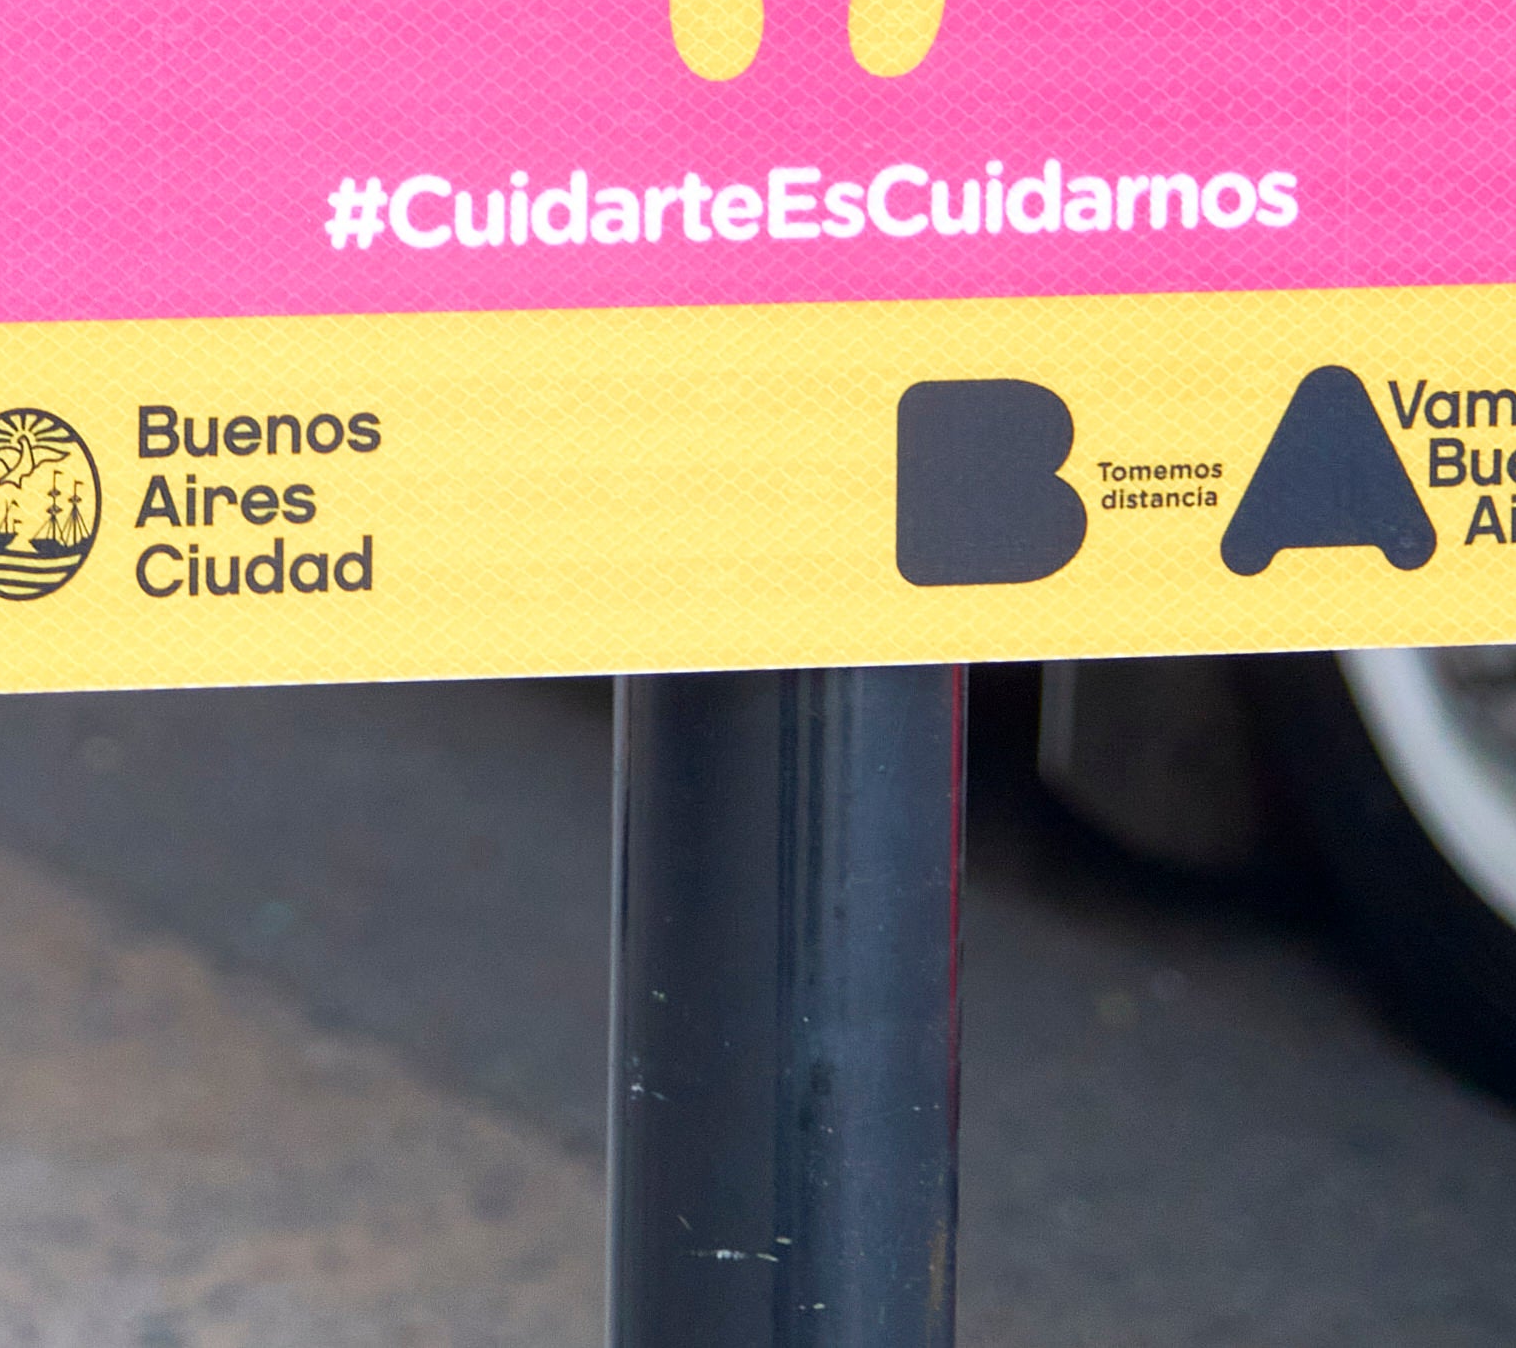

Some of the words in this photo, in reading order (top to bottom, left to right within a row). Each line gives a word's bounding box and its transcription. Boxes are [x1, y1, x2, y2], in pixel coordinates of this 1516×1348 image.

[324, 158, 1299, 250] #CuidarteEsCuidarnos
[138, 405, 381, 458] Buenos
[1097, 462, 1222, 482] Tomemos
[135, 474, 316, 528] Aires
[1101, 490, 1217, 510] distancia
[136, 535, 373, 598] Ciudad
